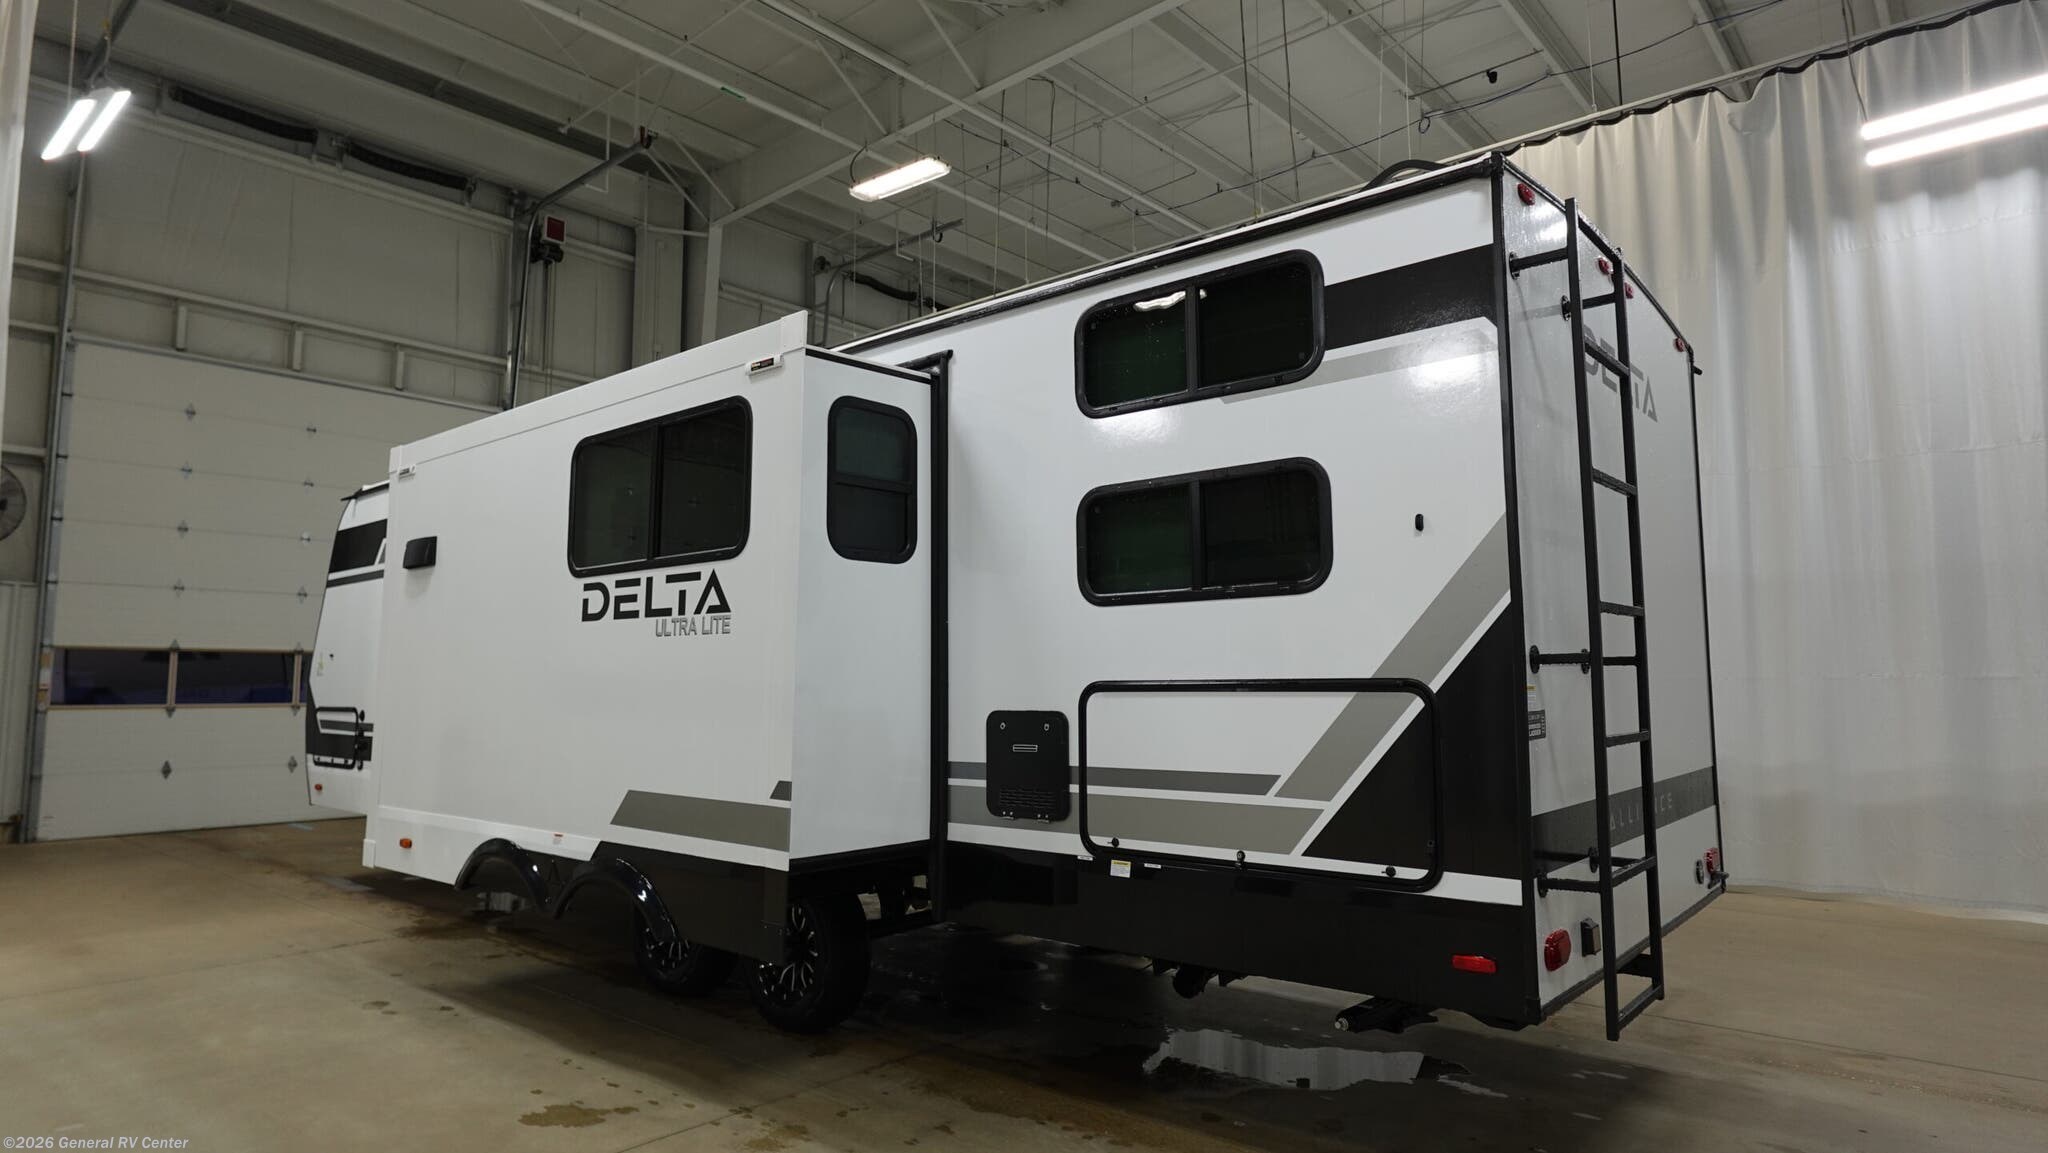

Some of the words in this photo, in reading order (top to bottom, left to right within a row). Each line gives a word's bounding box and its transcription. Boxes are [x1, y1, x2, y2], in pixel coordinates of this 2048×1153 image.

[1583, 323, 1658, 423] DETA
[581, 568, 732, 622] DELTA
[655, 617, 698, 637] ULTRA
[701, 615, 731, 635] LITE
[1609, 792, 1673, 831] ALLICE
